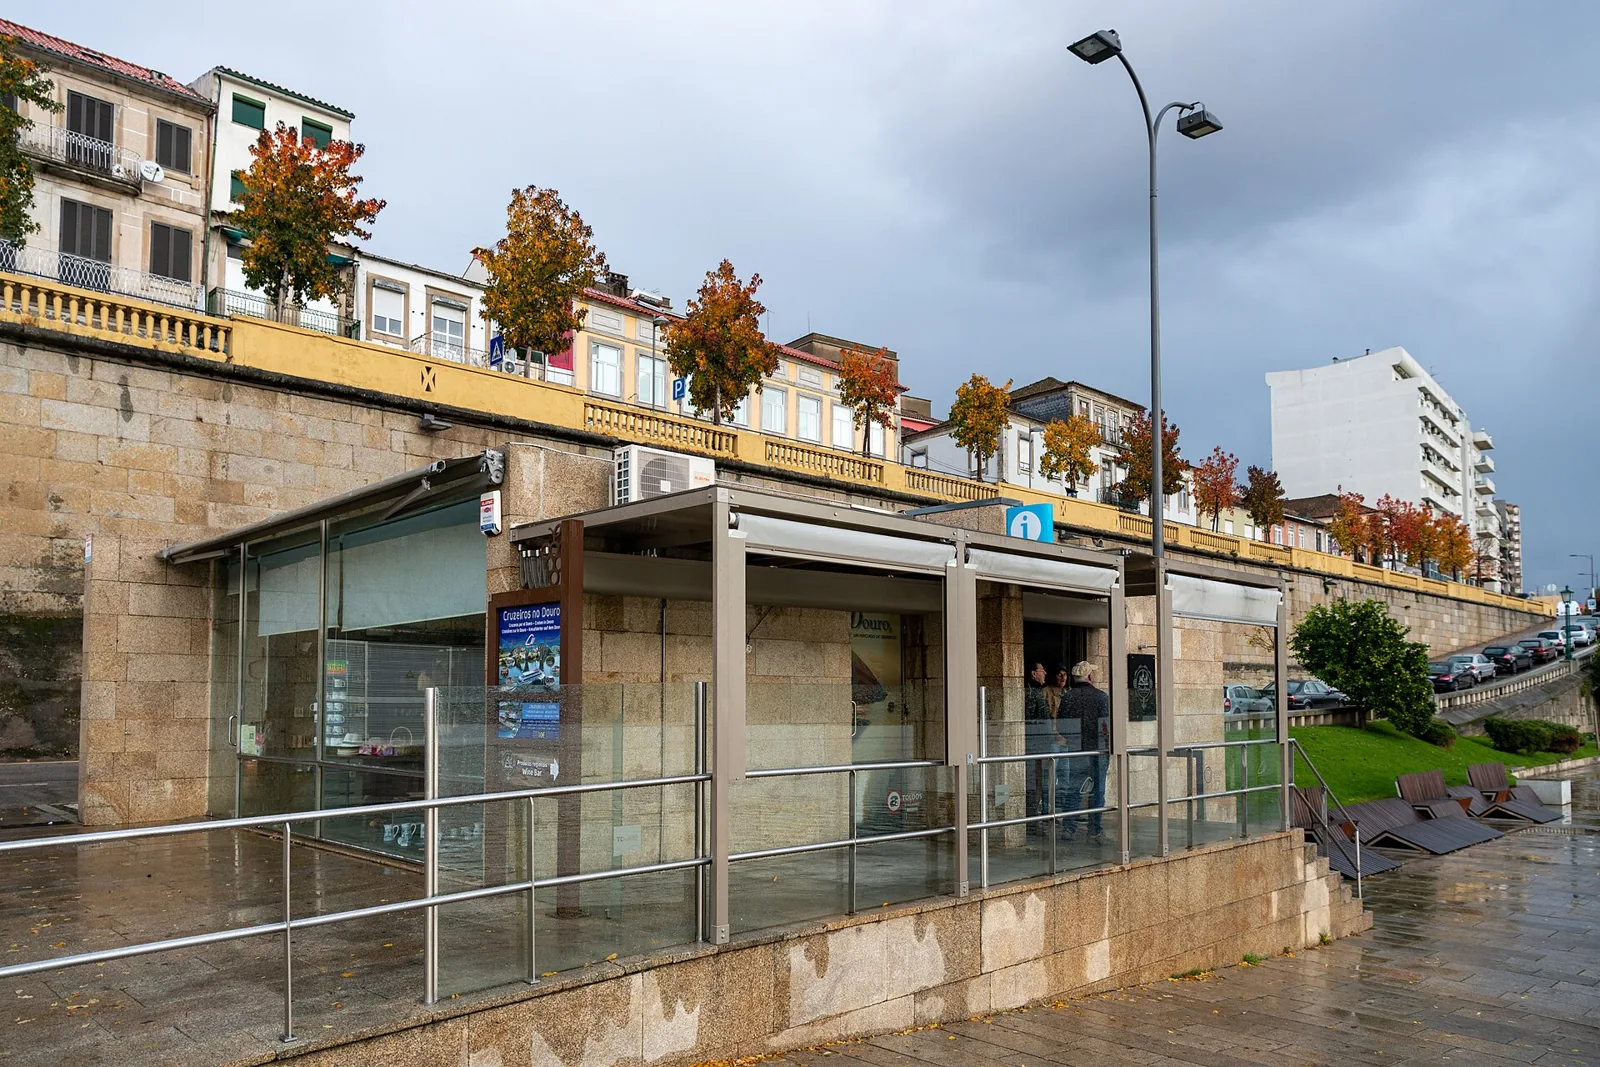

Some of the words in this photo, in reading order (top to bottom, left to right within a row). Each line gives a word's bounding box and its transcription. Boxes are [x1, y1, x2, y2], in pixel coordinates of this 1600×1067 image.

[674, 380, 682, 398] P
[503, 609, 531, 621] Cruzeiros
[532, 609, 540, 618] no
[542, 607, 560, 618] Douro
